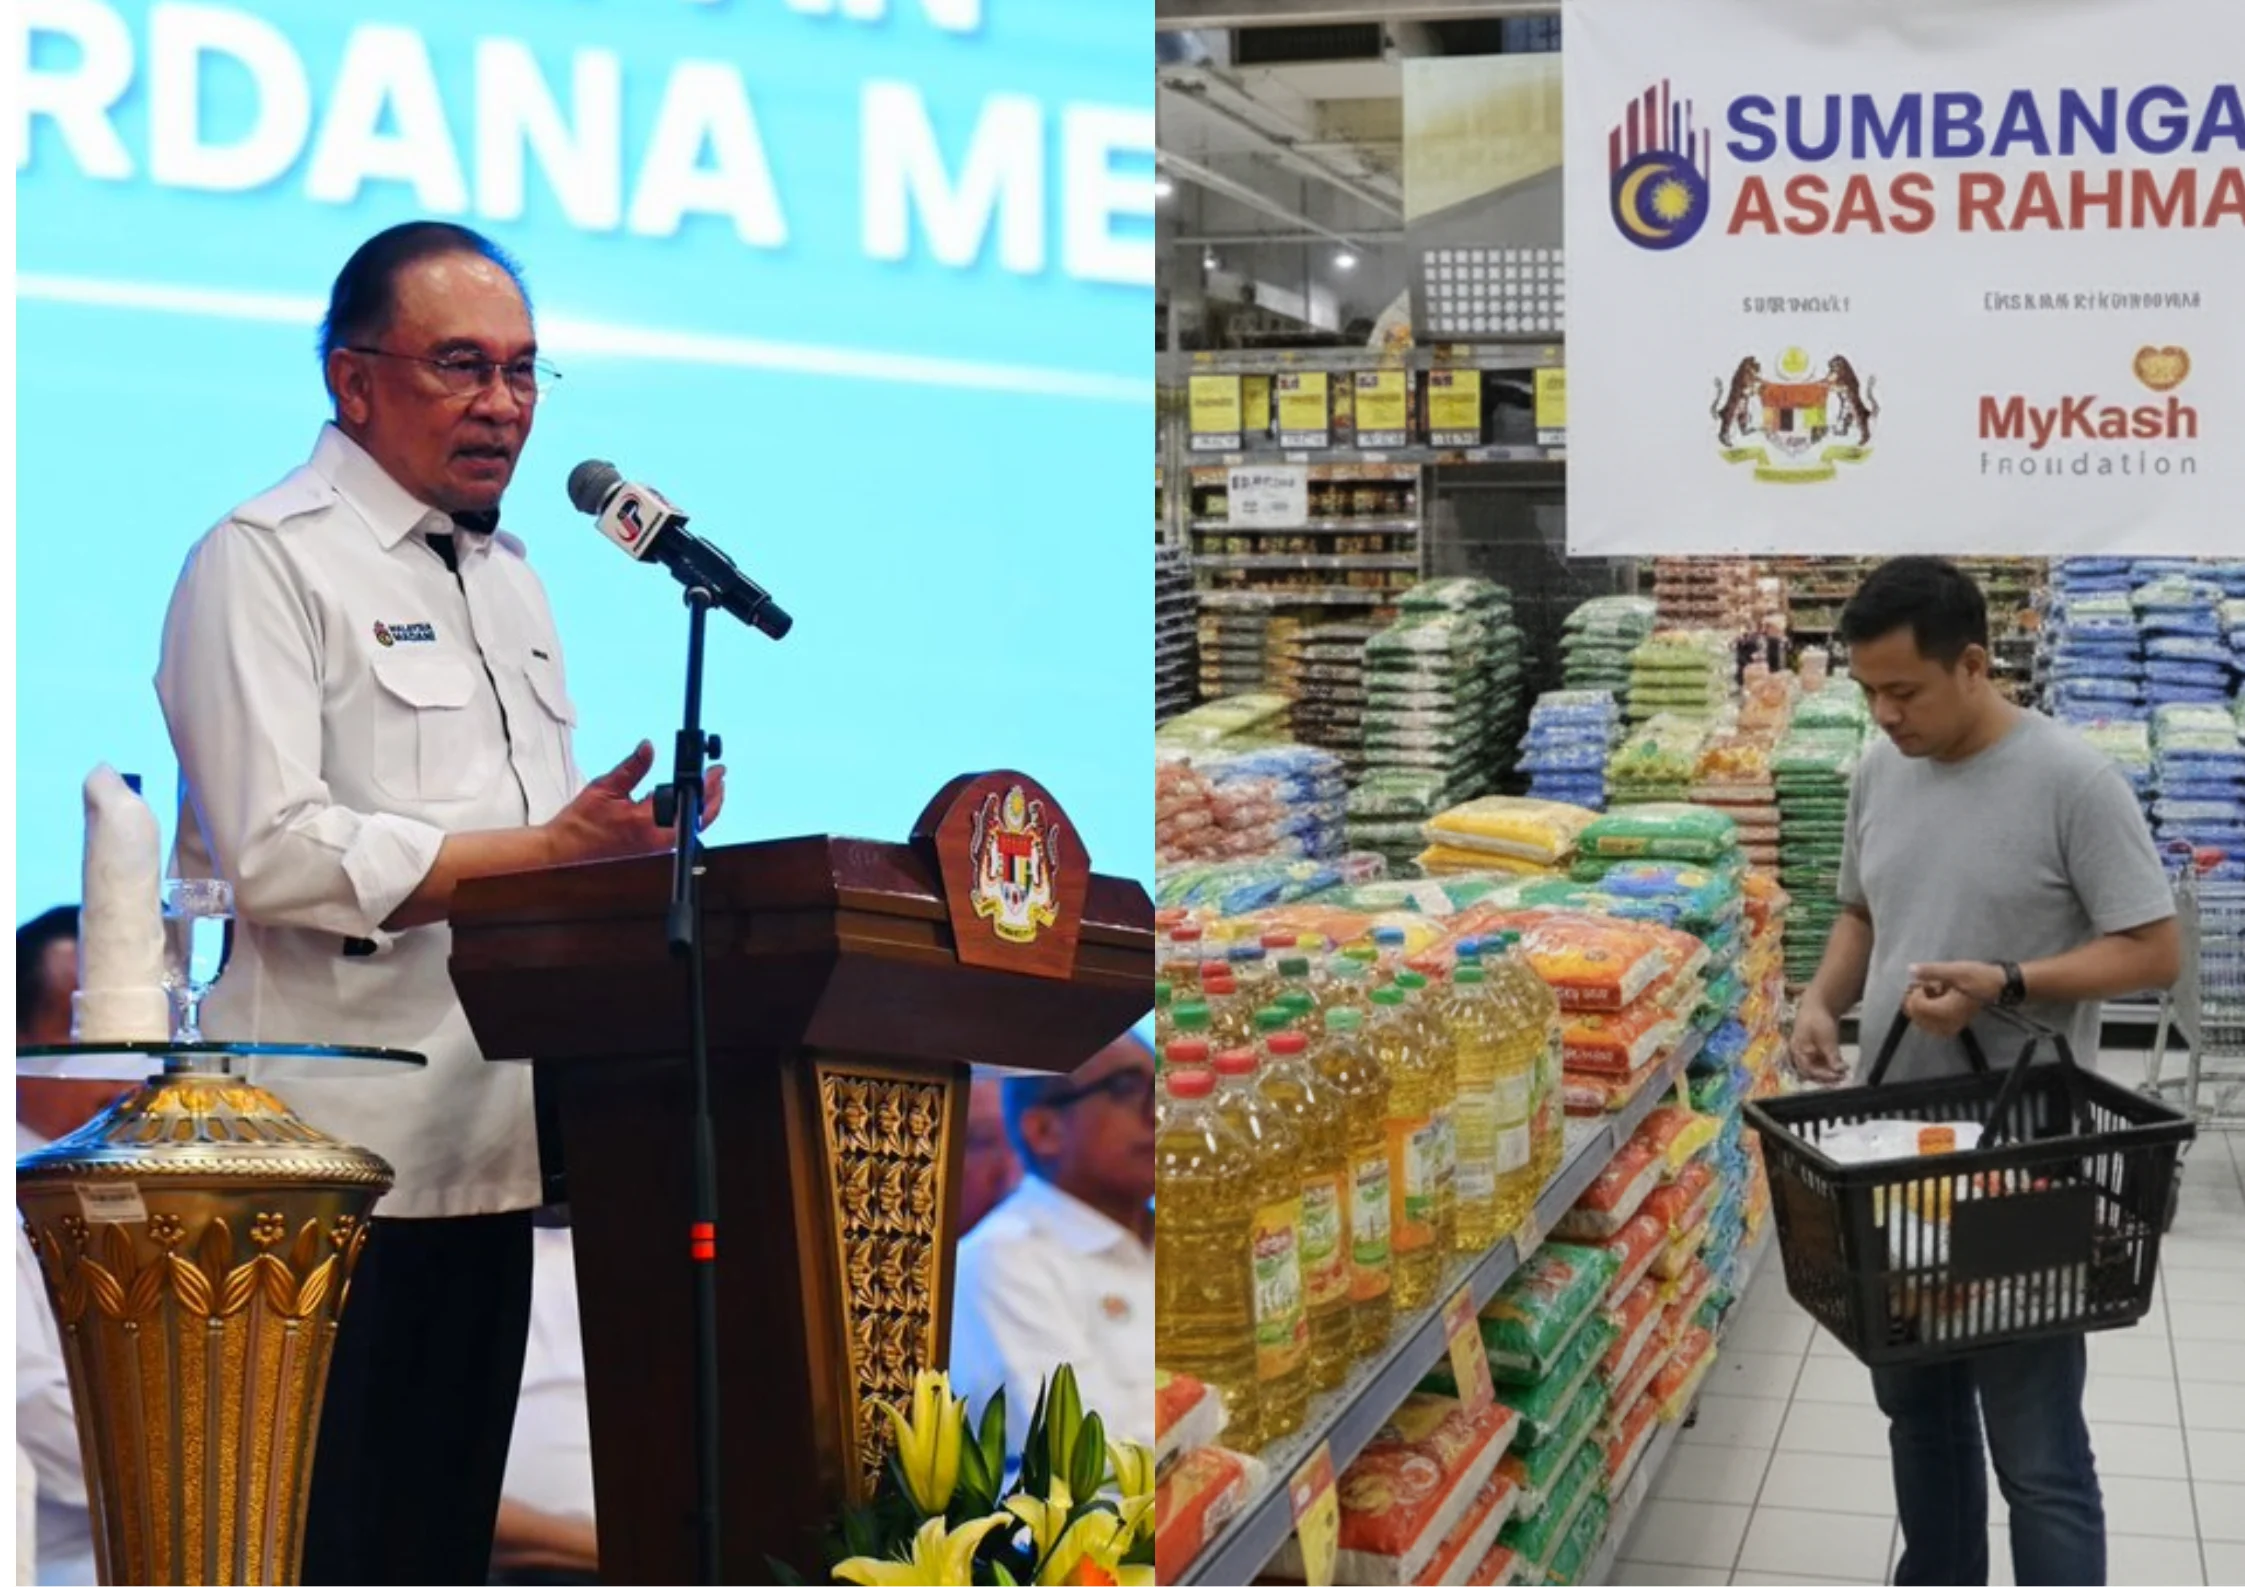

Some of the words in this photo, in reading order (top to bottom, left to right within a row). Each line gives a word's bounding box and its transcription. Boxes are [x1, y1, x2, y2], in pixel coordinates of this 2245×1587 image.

[16, 0, 788, 248] RDANA
[861, 80, 1155, 285] ME
[1726, 84, 2245, 162] SUMBANGA
[1727, 172, 1935, 235] ASAS
[1958, 167, 2245, 232] RAHMA
[1979, 395, 2197, 449] MyKash
